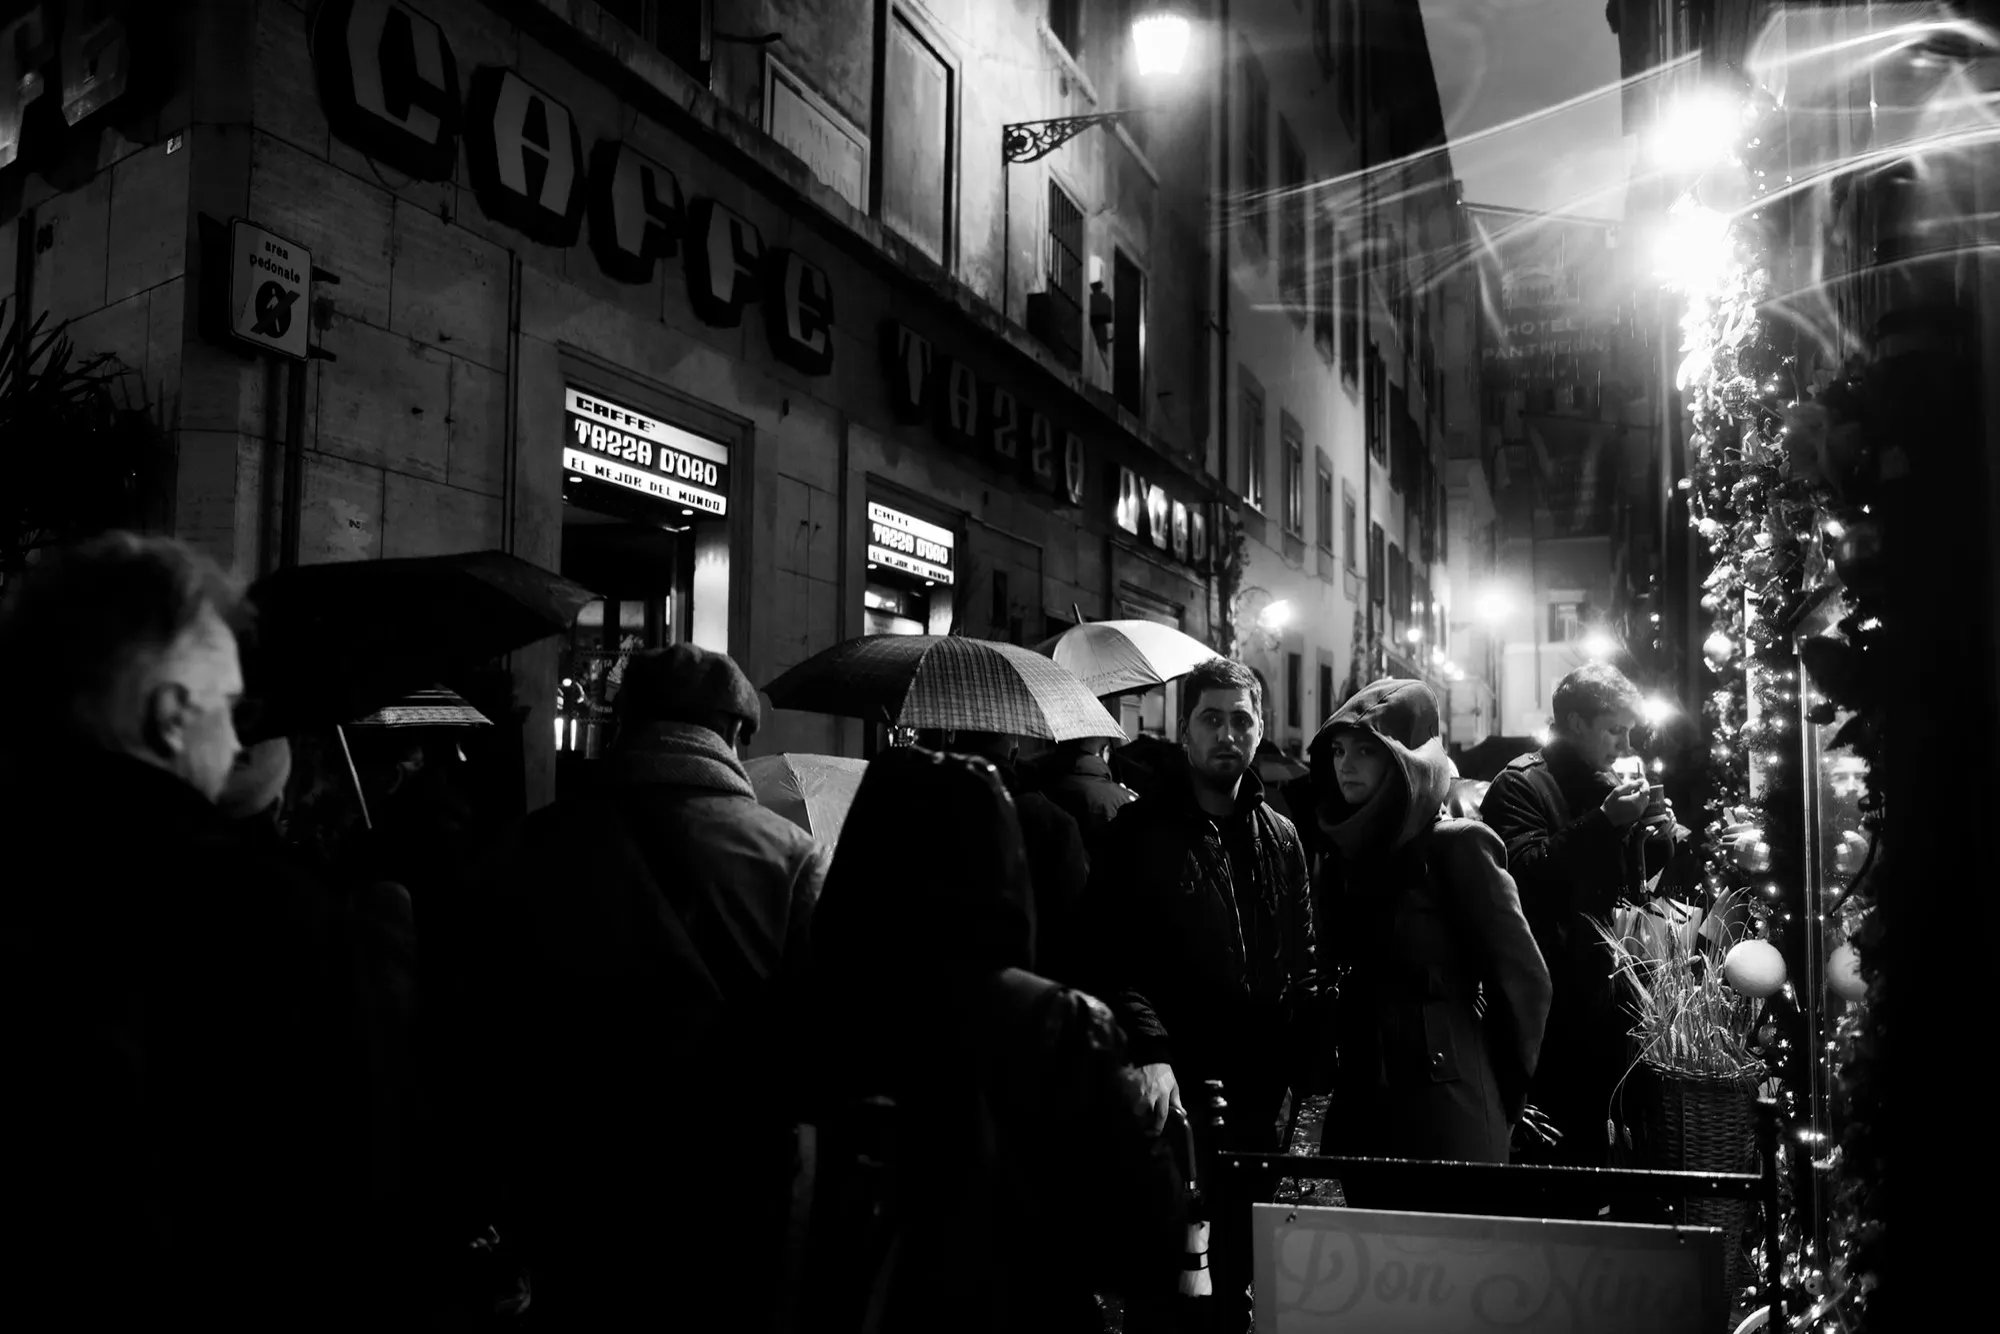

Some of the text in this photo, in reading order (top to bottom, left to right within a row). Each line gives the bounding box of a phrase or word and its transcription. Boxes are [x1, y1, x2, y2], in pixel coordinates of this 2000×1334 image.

[265, 241, 288, 260] area
[249, 253, 301, 284] pedonale
[1504, 317, 1580, 338] HOTEL
[571, 457, 720, 511] EL MEJOR DEL MUNDO
[659, 447, 717, 487] D'ORO
[1276, 1220, 1456, 1317] Don
